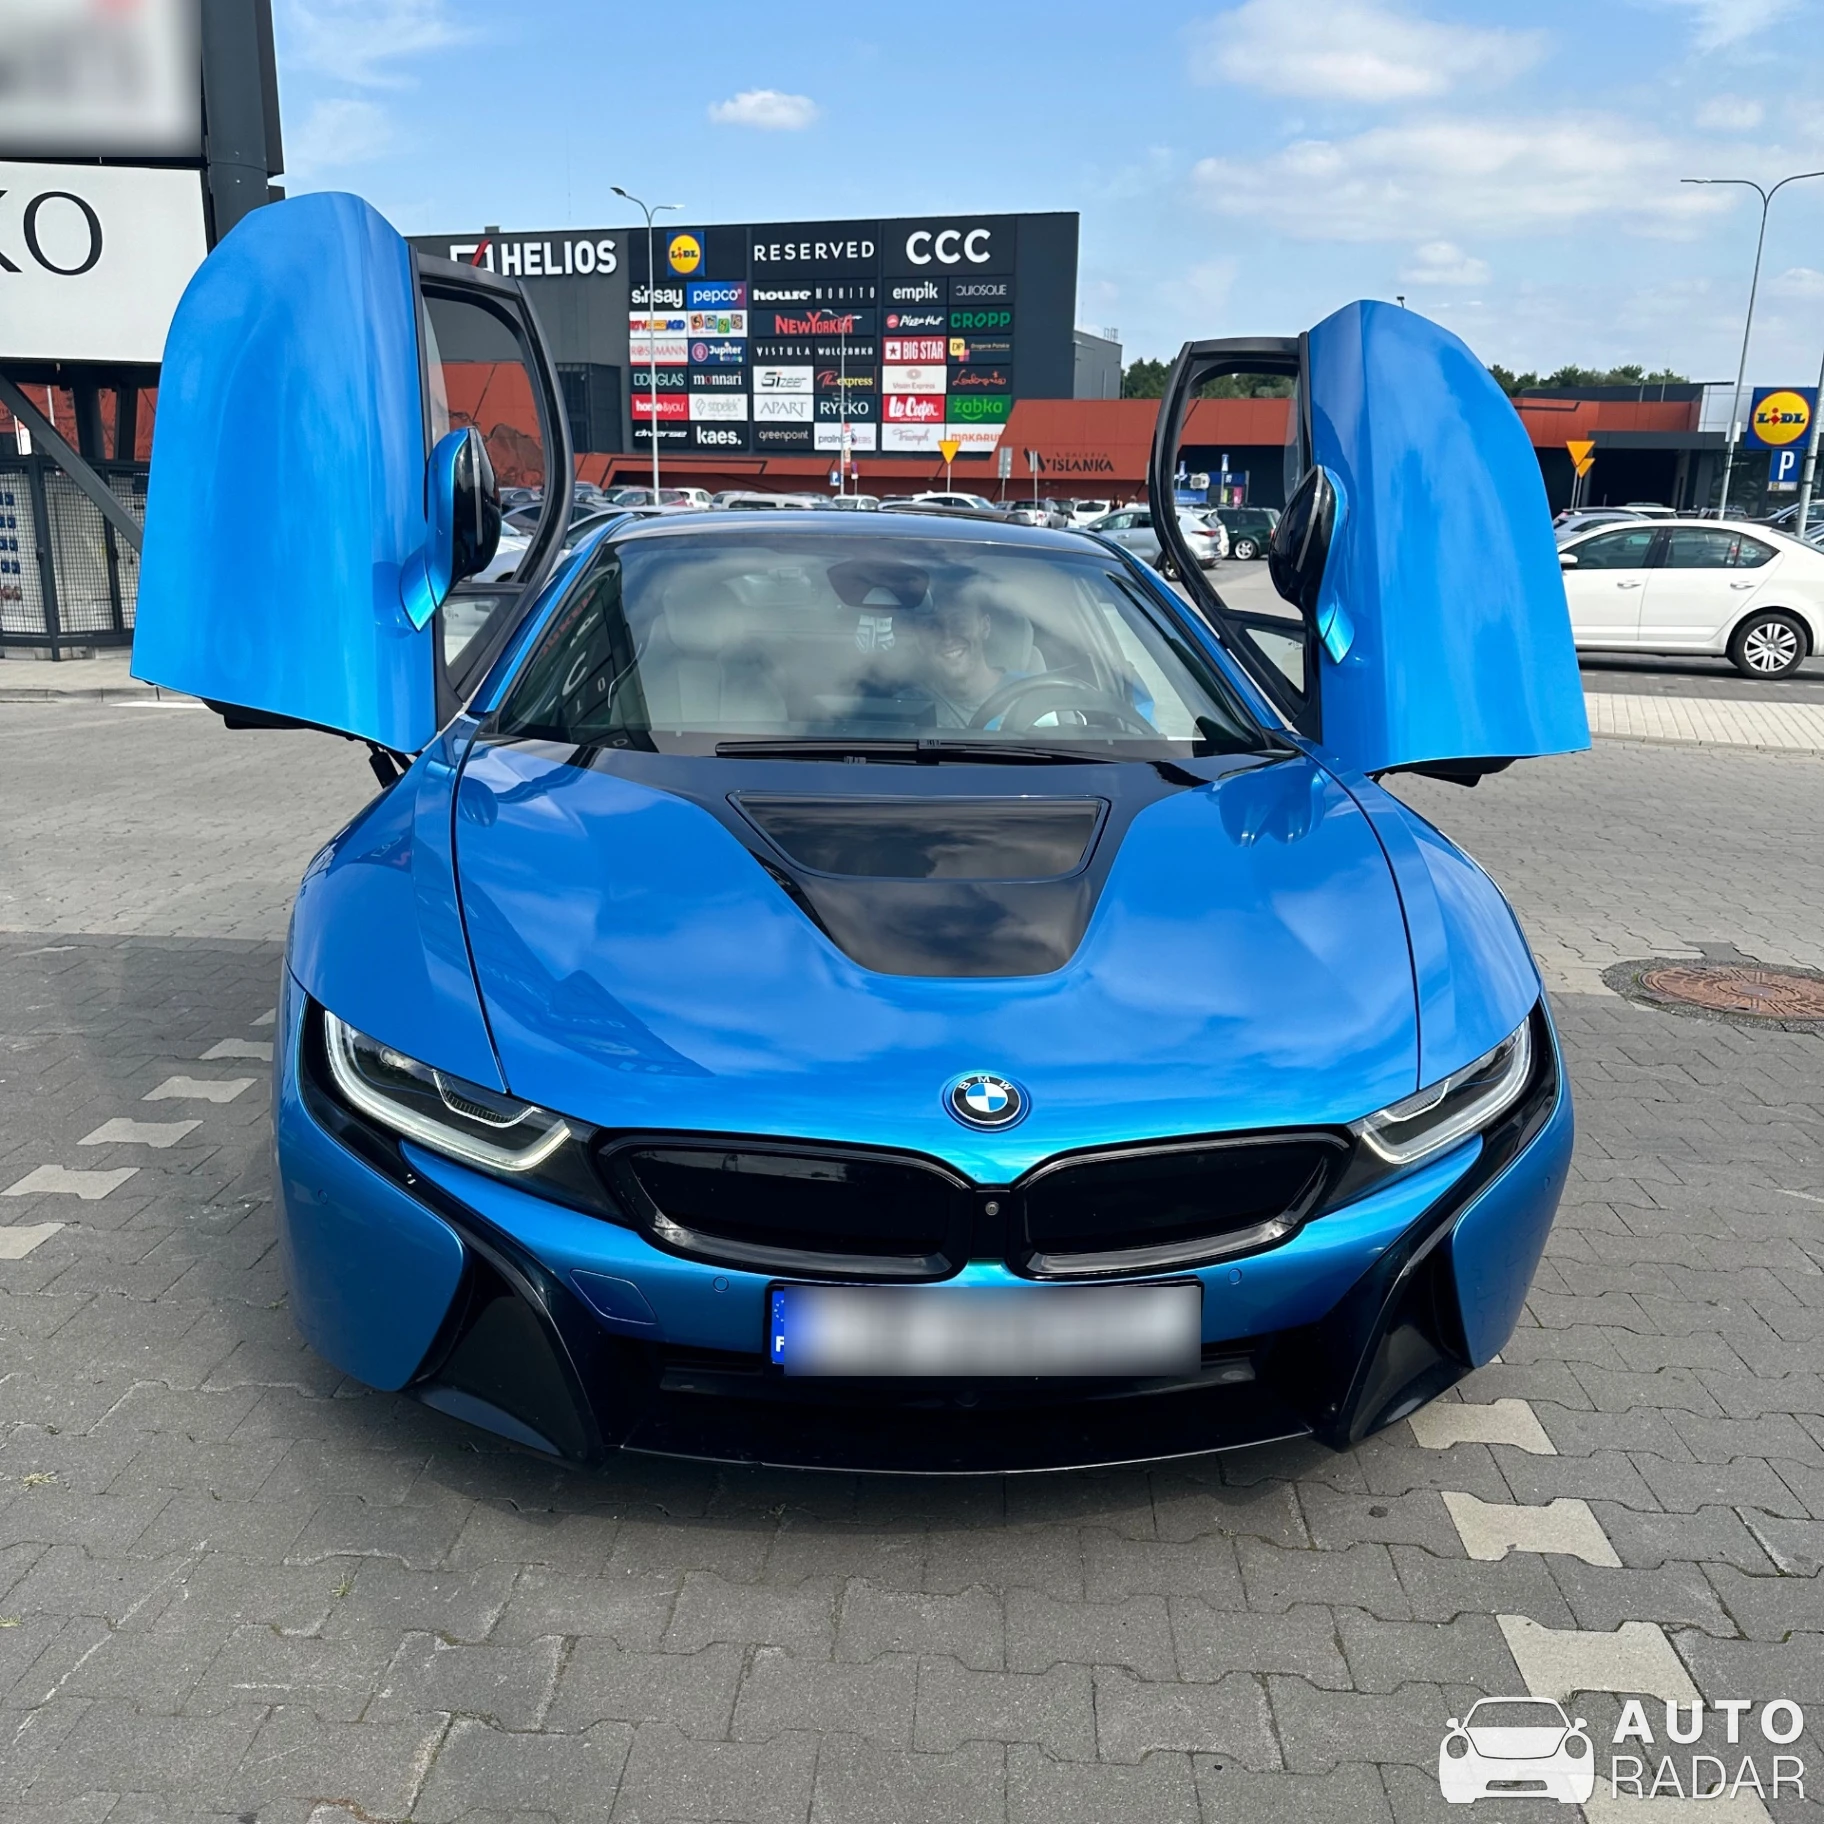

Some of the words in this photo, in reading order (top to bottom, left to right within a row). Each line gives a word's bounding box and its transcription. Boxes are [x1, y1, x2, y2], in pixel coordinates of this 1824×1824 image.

[753, 241, 875, 261] RESERVED
[905, 228, 991, 265] CCC
[501, 240, 617, 276] HELIOS
[693, 290, 738, 304] pepco
[753, 289, 812, 301] house
[892, 281, 938, 302] empik
[950, 312, 1011, 328] CROPP
[709, 341, 742, 357] Jupiter
[756, 346, 811, 357] VISTULA
[902, 340, 919, 360] BIG
[920, 340, 944, 360] STAR
[693, 371, 742, 386] monnari
[759, 402, 807, 418] APART
[953, 398, 1003, 414] żabka
[697, 425, 742, 445] kaes.
[759, 430, 808, 442] greenpoint
[1778, 451, 1795, 480] P
[958, 1075, 1012, 1091] BMW
